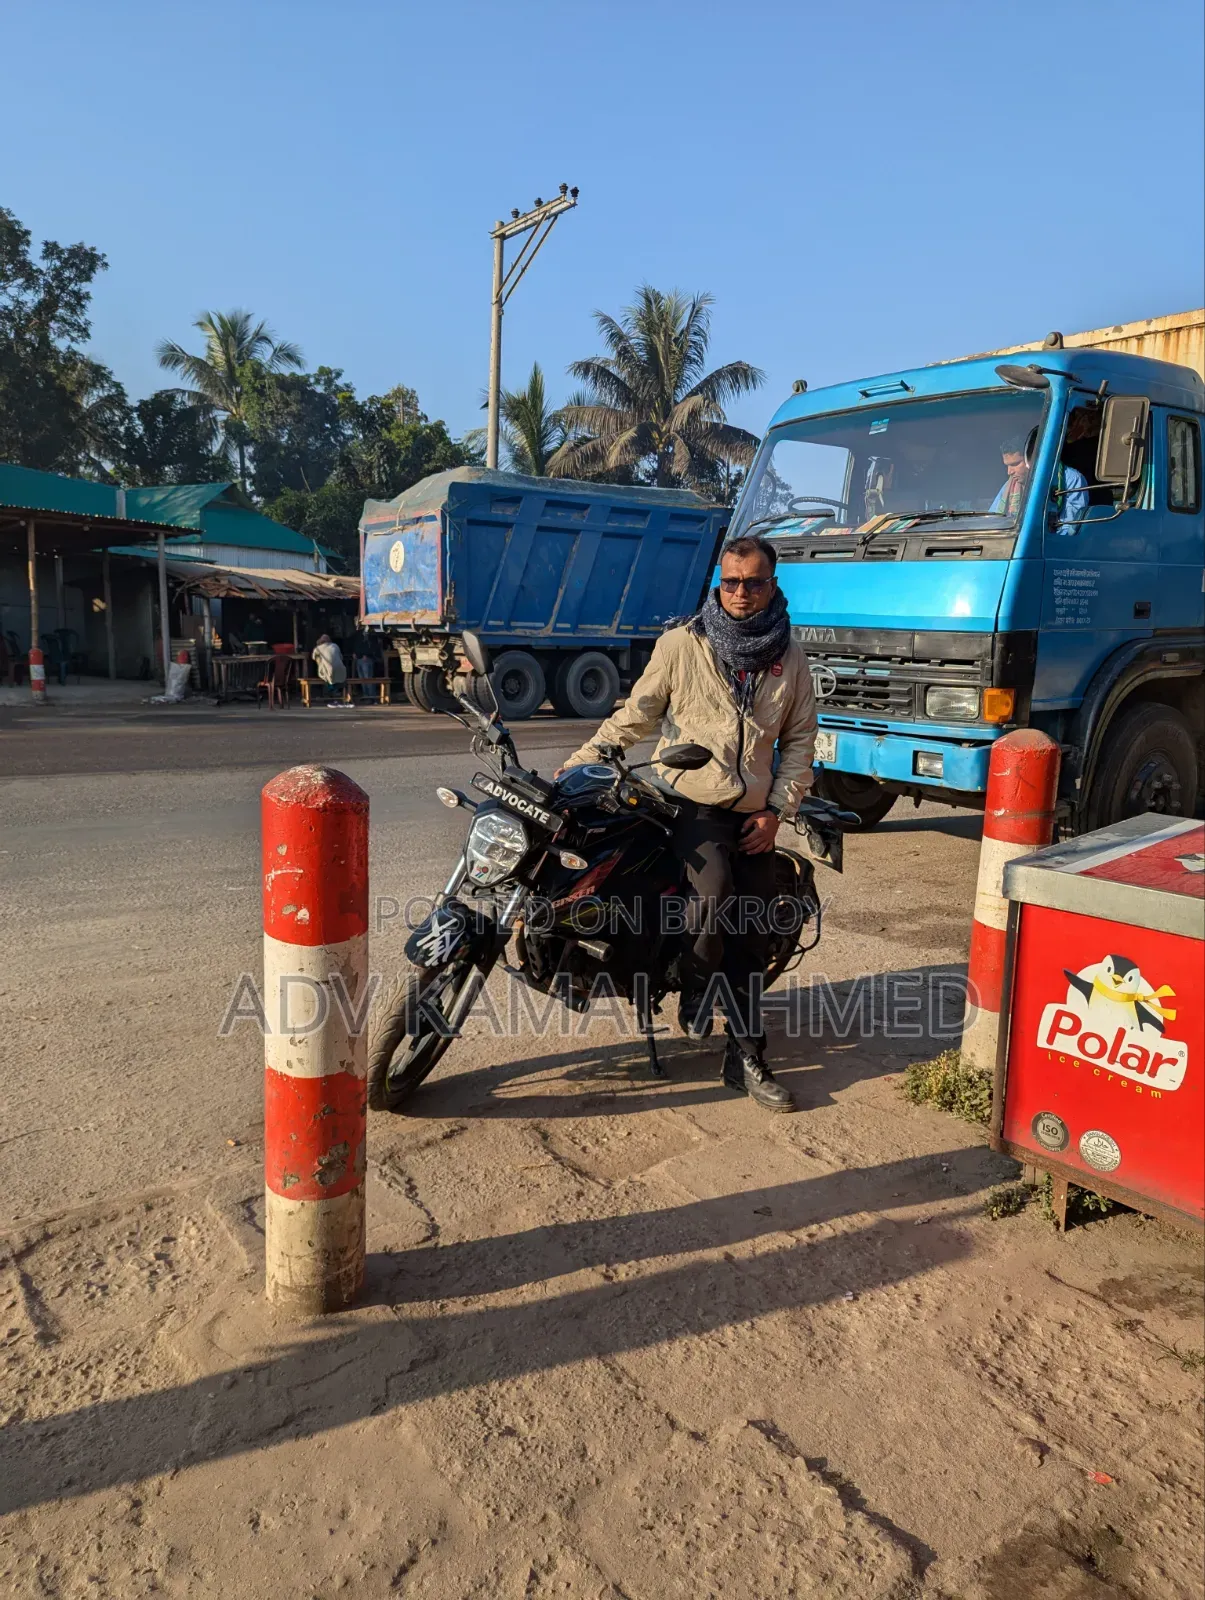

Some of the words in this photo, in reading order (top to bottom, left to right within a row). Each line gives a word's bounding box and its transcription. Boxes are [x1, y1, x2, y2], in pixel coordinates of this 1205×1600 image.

[799, 627, 836, 643] TATA
[484, 781, 550, 824] ADVOCATE
[1045, 1008, 1179, 1079] Polar
[1047, 1051, 1080, 1068] ice
[1093, 1068, 1162, 1099] cream
[1042, 1123, 1059, 1136] ISO
